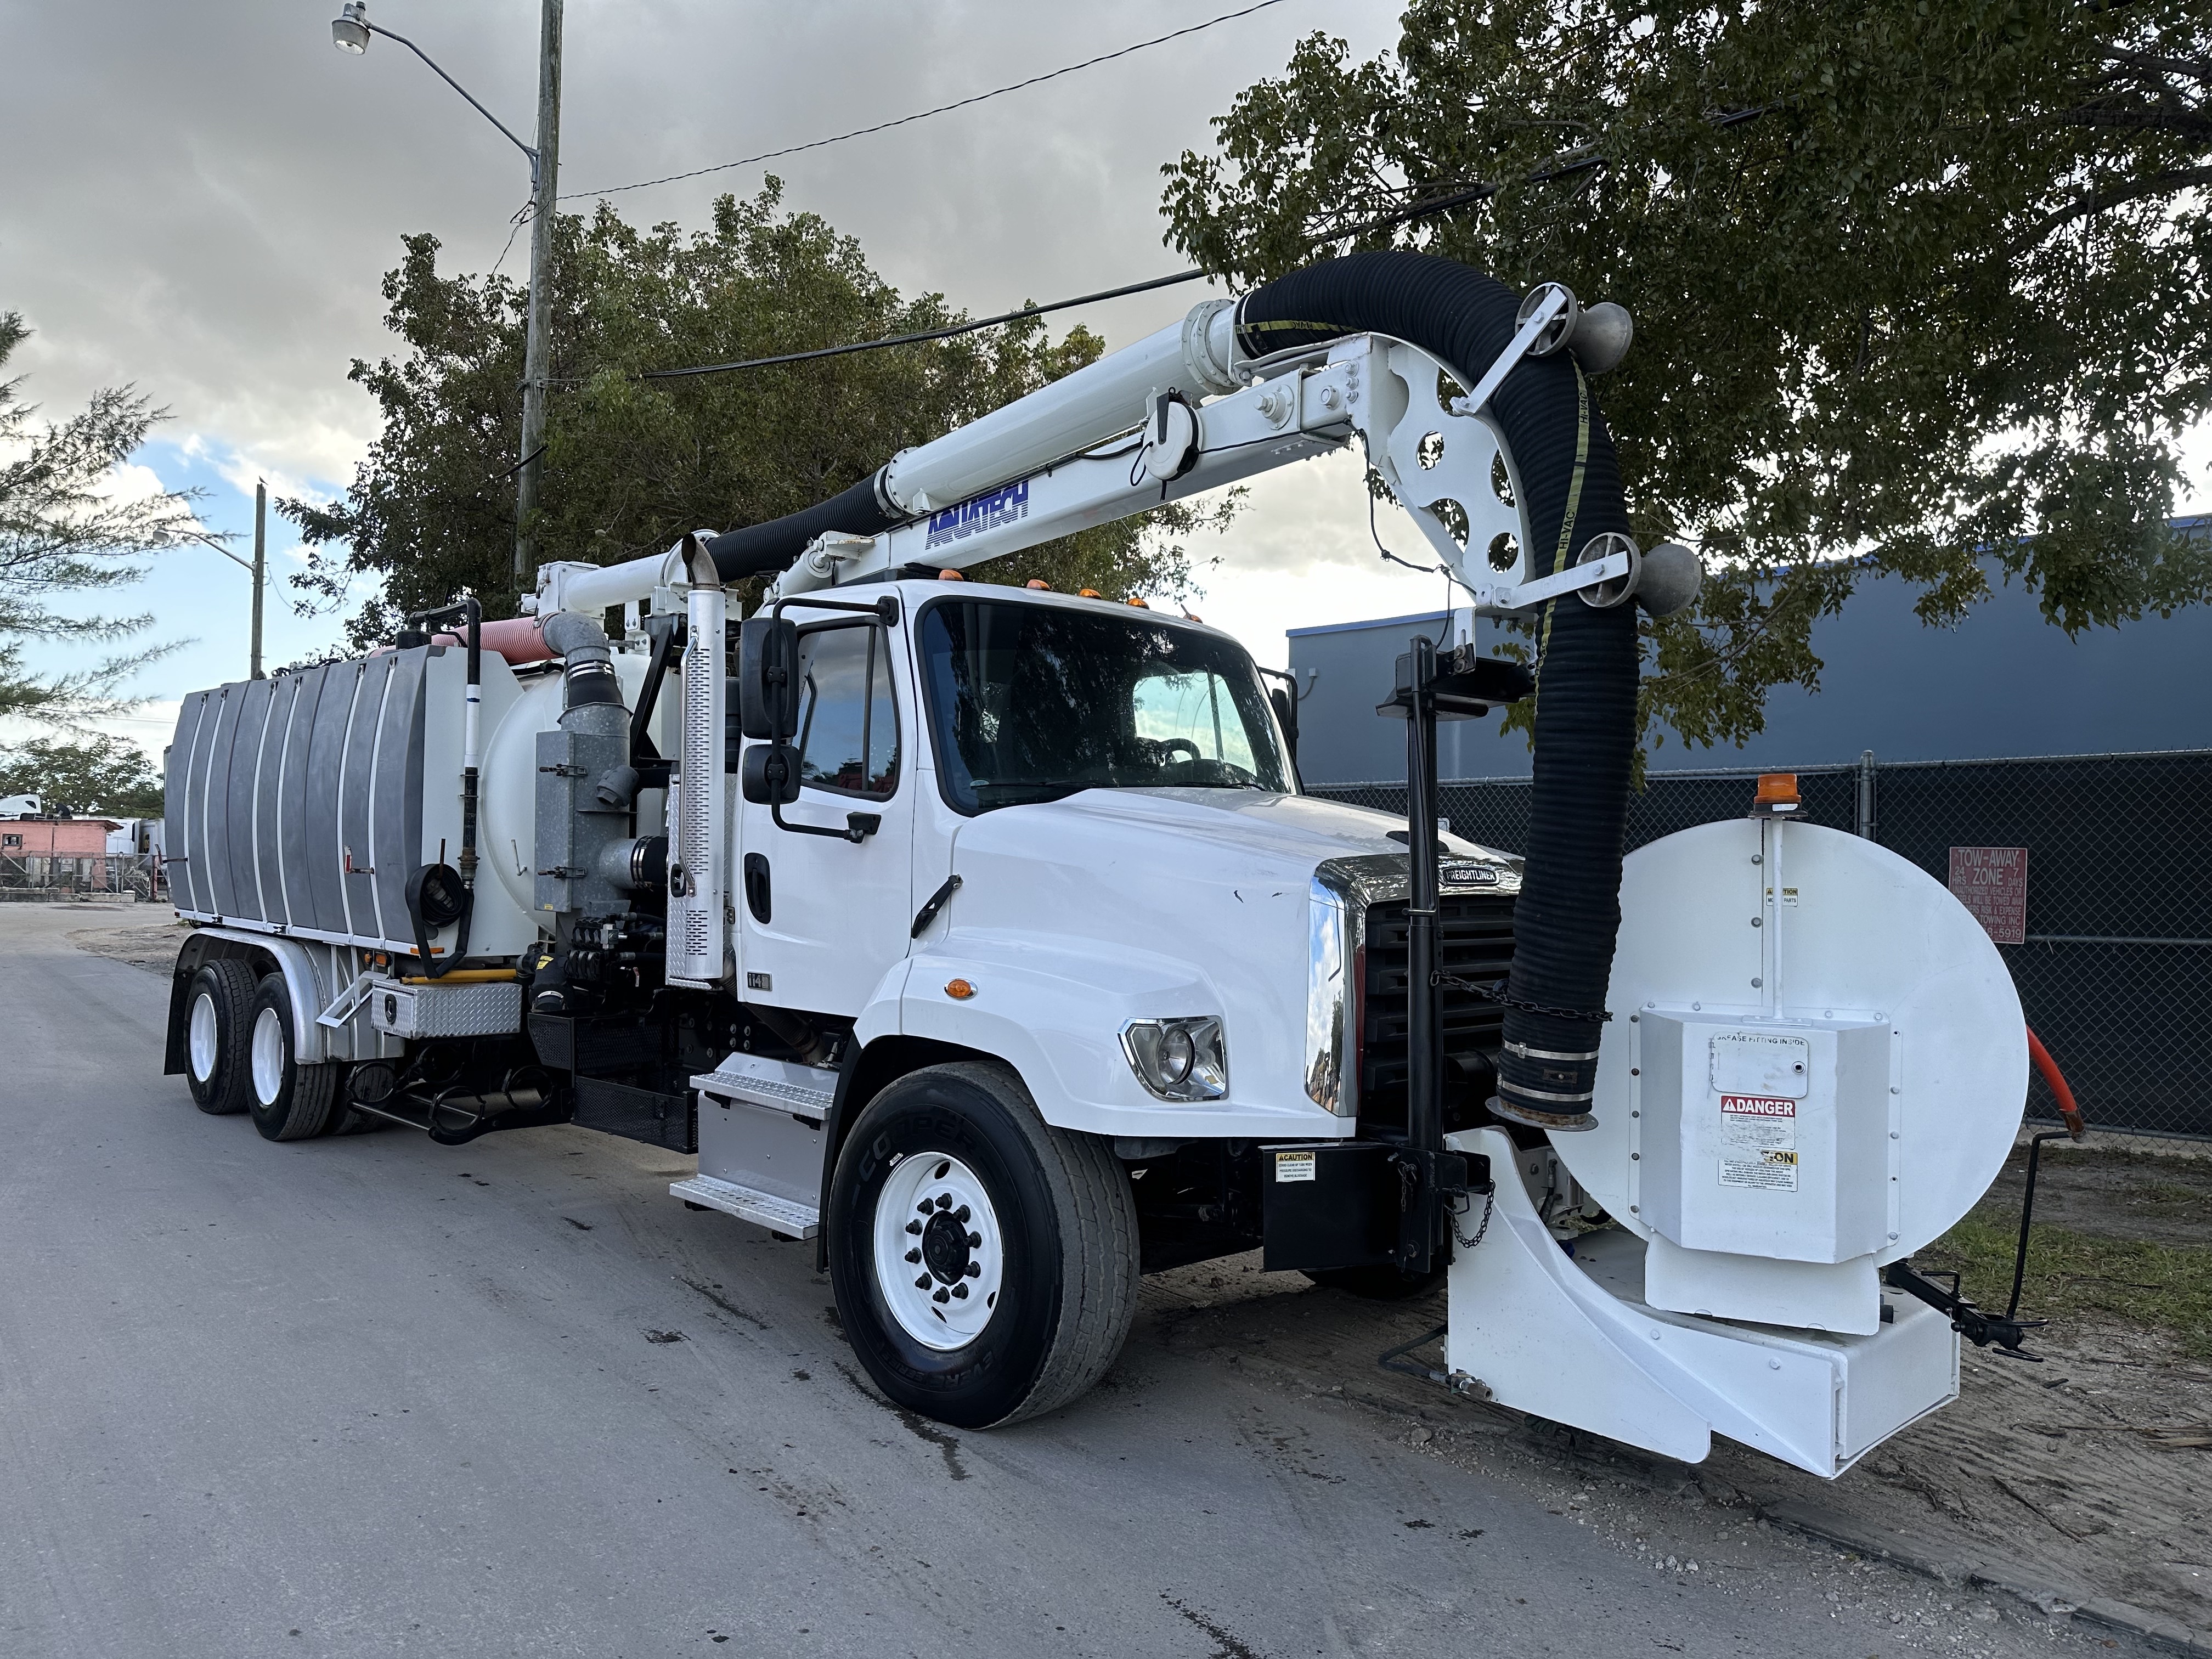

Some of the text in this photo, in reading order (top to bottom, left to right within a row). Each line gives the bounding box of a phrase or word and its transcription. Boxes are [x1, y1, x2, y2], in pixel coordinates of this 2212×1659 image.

[1579, 392, 1588, 424] HI-VAC
[1559, 511, 1575, 549] HI-VAC
[1958, 849, 2019, 867] TOW-AWAY
[1446, 870, 1495, 881] FREIGHTLINER
[1955, 866, 1965, 876] 24
[1972, 867, 2004, 885] ZONE
[2013, 868, 2019, 877] 7
[1952, 876, 1967, 885] HRS
[2008, 878, 2023, 887] DAYS
[1990, 887, 2013, 896] VEHICLES
[2015, 888, 2022, 896] OR
[1993, 896, 2010, 906] TOWED
[1999, 906, 2022, 916] EXPENSE
[1980, 915, 2006, 925] TOWING
[1984, 927, 2022, 938] 8-5919
[1736, 1099, 1793, 1115] DANGER
